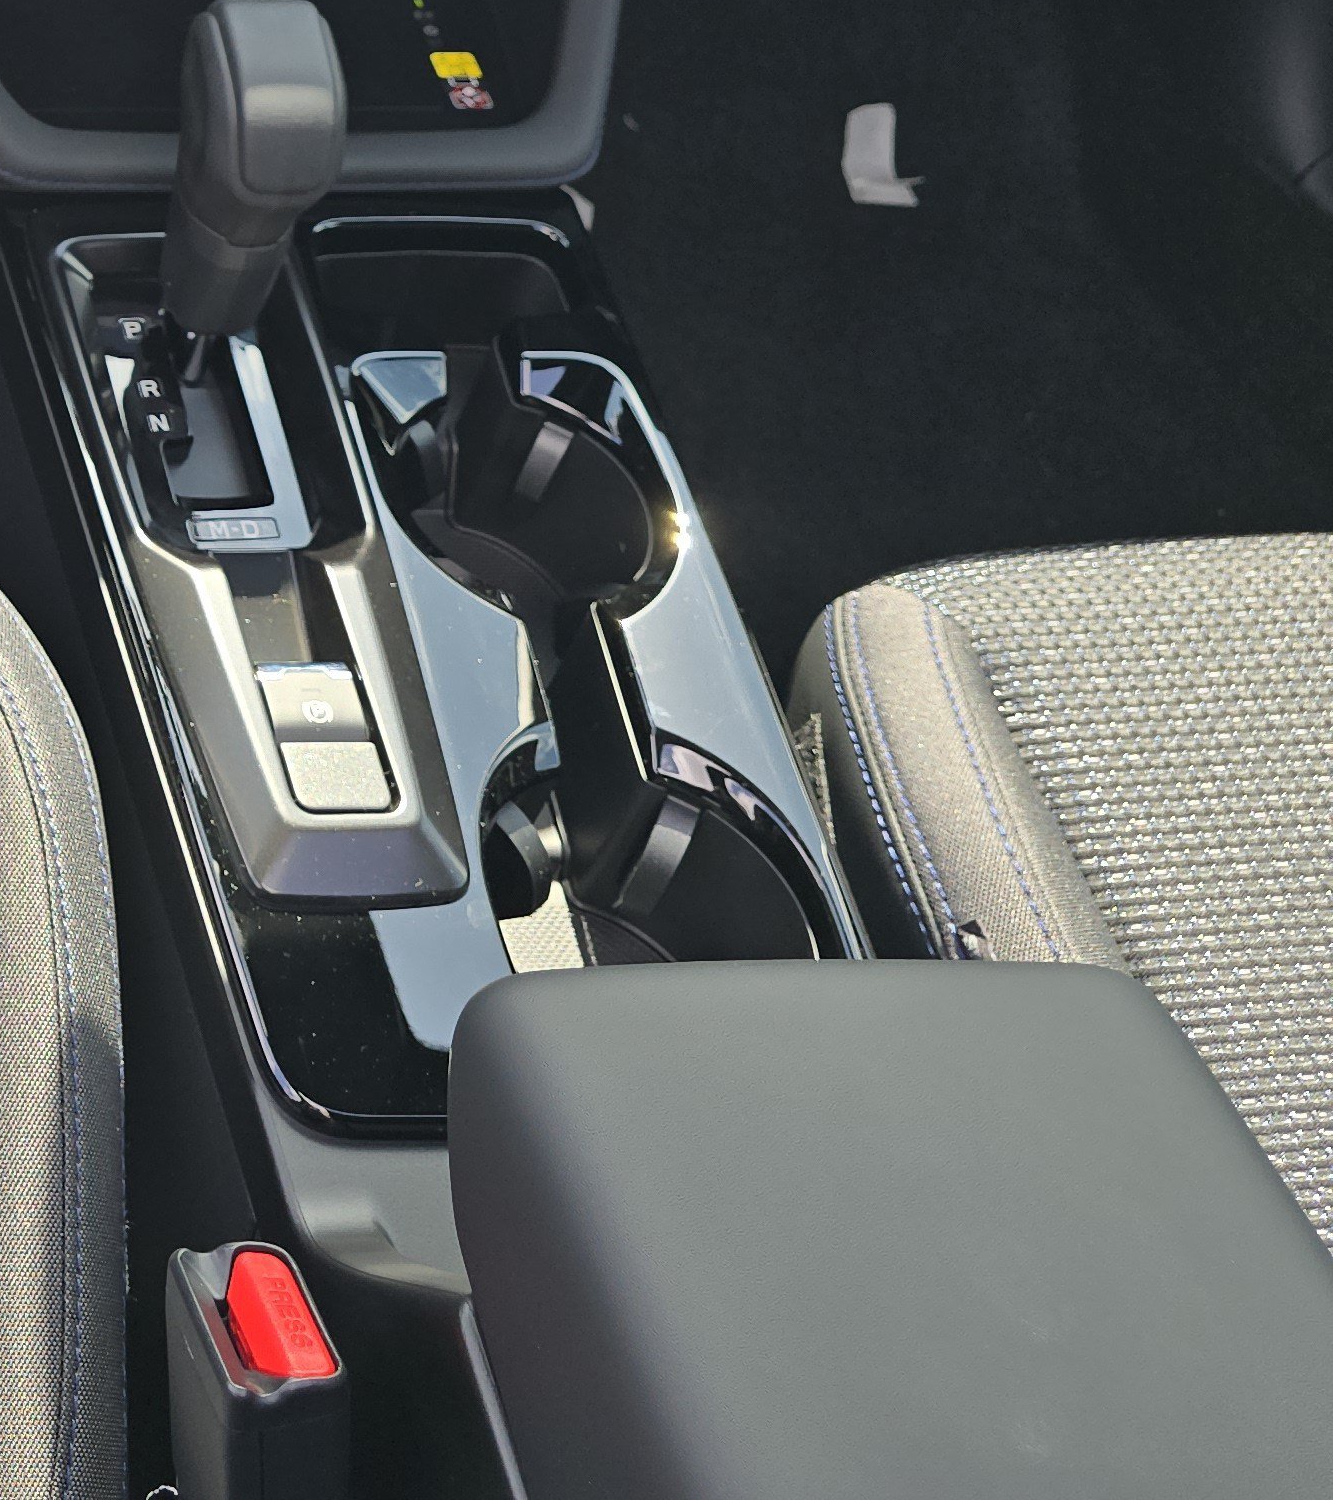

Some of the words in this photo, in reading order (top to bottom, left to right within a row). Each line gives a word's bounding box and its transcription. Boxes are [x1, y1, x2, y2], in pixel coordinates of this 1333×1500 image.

[123, 322, 142, 339] P
[137, 379, 161, 398] R
[148, 414, 171, 433] N
[262, 1275, 314, 1350] PRESS
